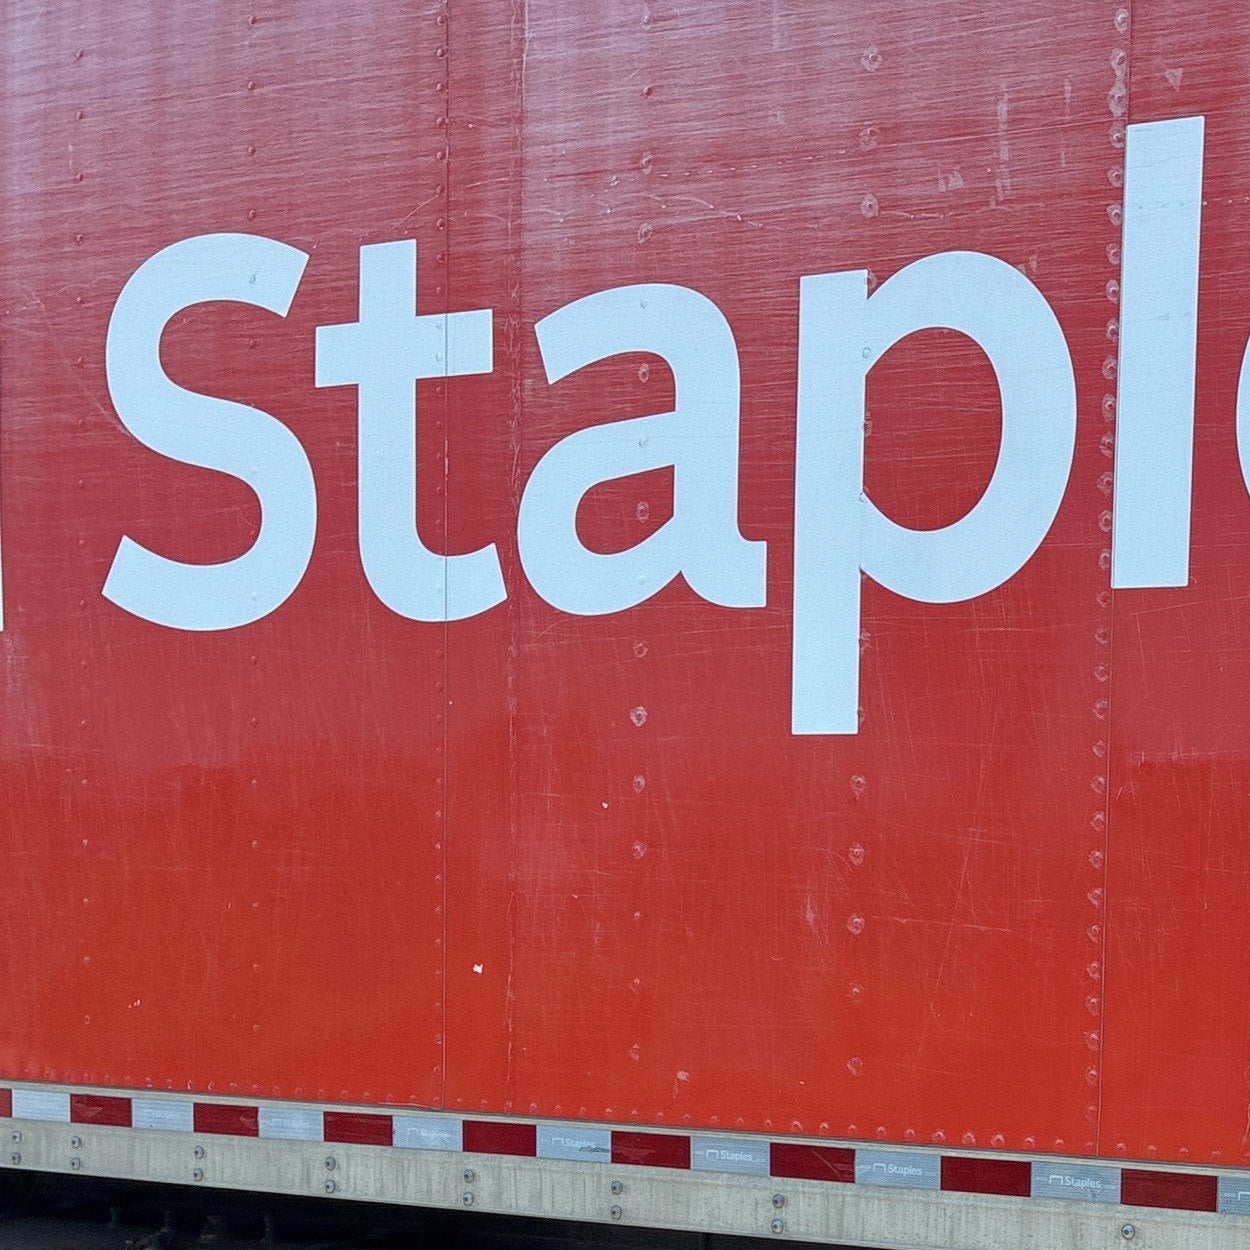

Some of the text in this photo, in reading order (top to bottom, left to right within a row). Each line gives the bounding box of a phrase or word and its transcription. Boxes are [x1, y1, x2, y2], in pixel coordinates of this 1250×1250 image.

[565, 1138, 596, 1149] Staples
[721, 1150, 753, 1162] Staples
[888, 1163, 923, 1177] Staples
[1064, 1176, 1102, 1189] Staples
